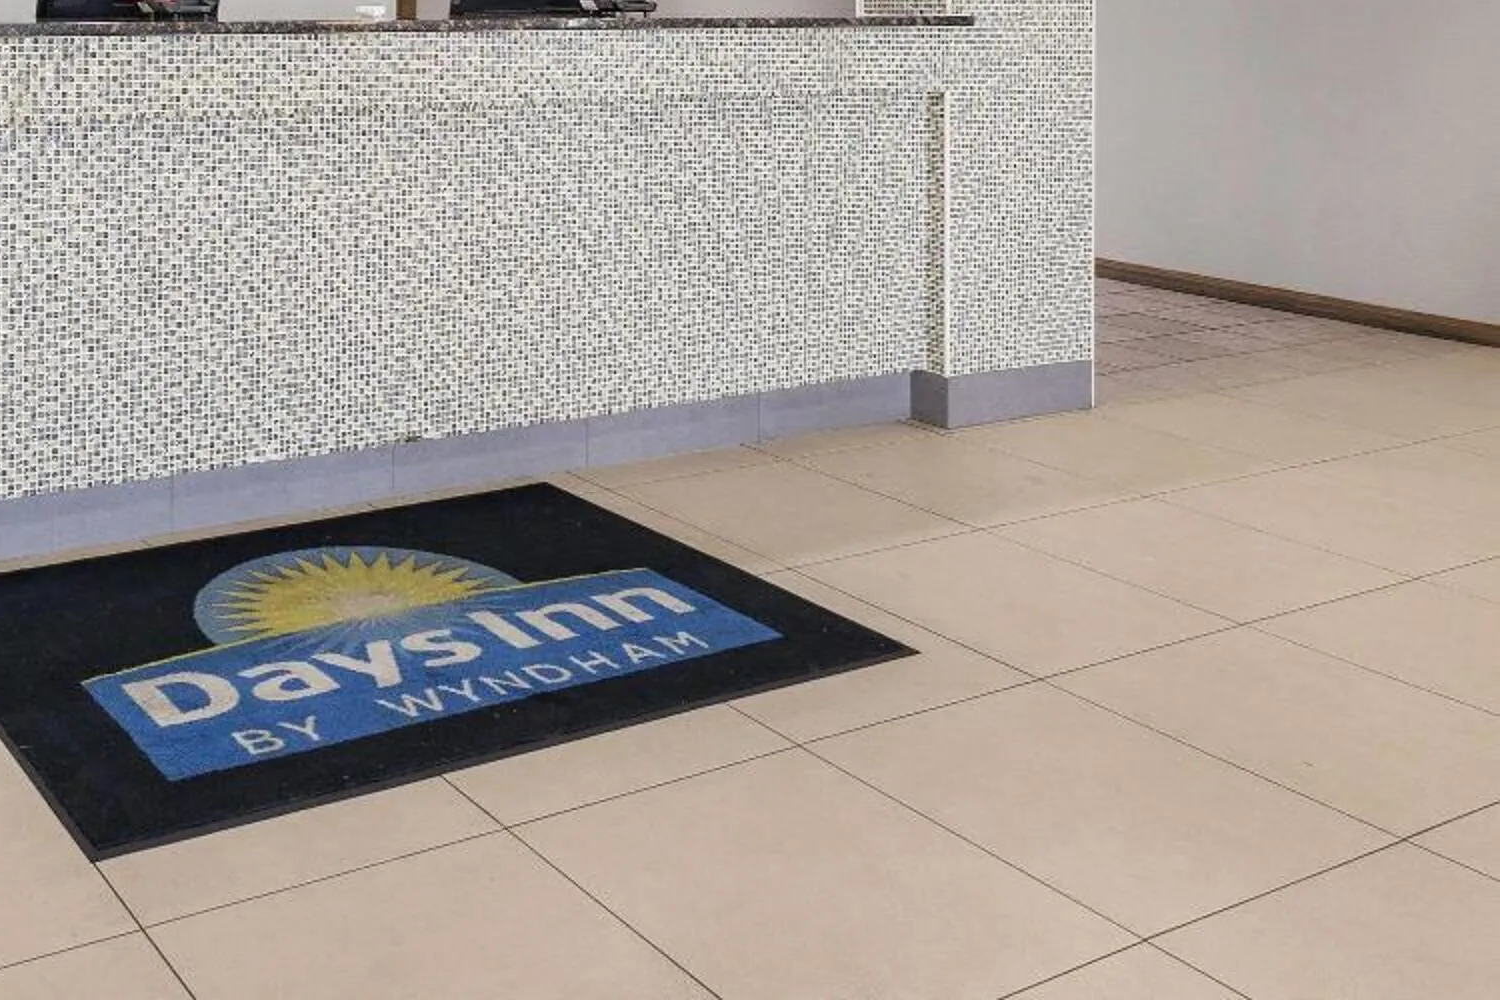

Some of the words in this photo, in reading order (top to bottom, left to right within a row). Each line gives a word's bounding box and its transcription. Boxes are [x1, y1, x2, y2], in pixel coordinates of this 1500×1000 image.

[121, 628, 482, 728] Days
[466, 586, 696, 649] Inn
[231, 714, 321, 756] BY
[374, 630, 710, 717] WYNDHAM
